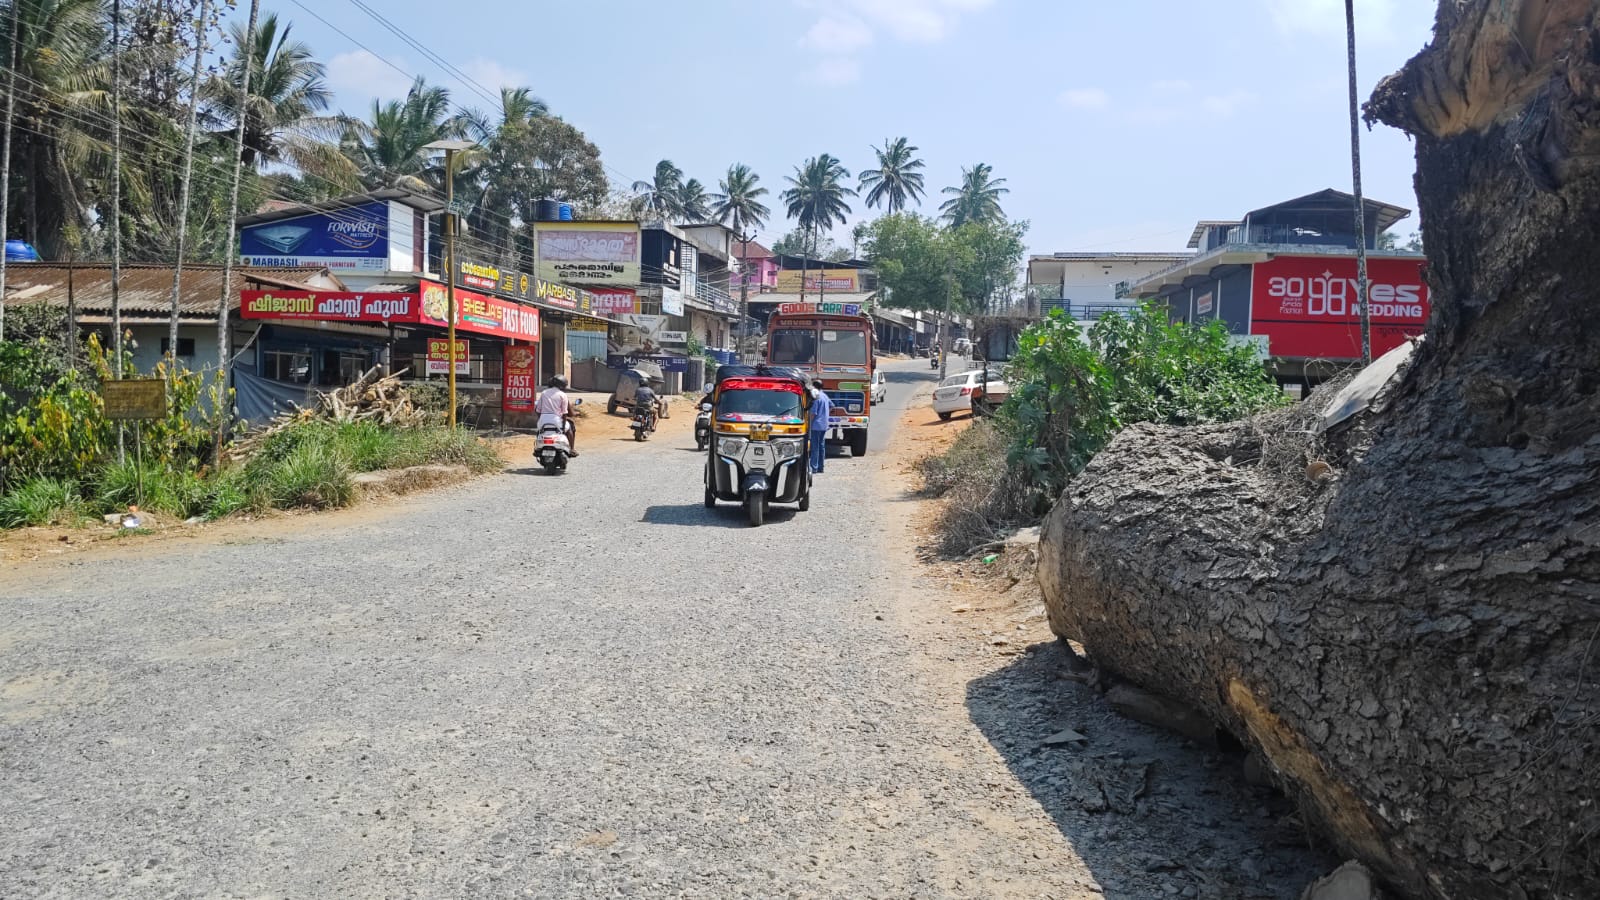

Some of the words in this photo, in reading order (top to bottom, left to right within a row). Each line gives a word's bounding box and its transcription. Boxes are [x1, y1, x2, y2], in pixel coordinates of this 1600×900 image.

[327, 220, 376, 233] FORWISH
[252, 257, 299, 267] MARBASIL
[536, 280, 577, 302] MARBASIL
[1268, 277, 1304, 297] 30
[1348, 278, 1421, 302] Yes
[248, 294, 316, 313] ഷീജാസ്
[365, 297, 410, 318] ഫുഡ്
[781, 302, 815, 314] GOODS
[816, 302, 858, 316] CARRIER
[502, 307, 519, 333] FAST
[520, 311, 538, 337] FOOD
[508, 375, 530, 387] FAST
[506, 387, 532, 398] FOOD
